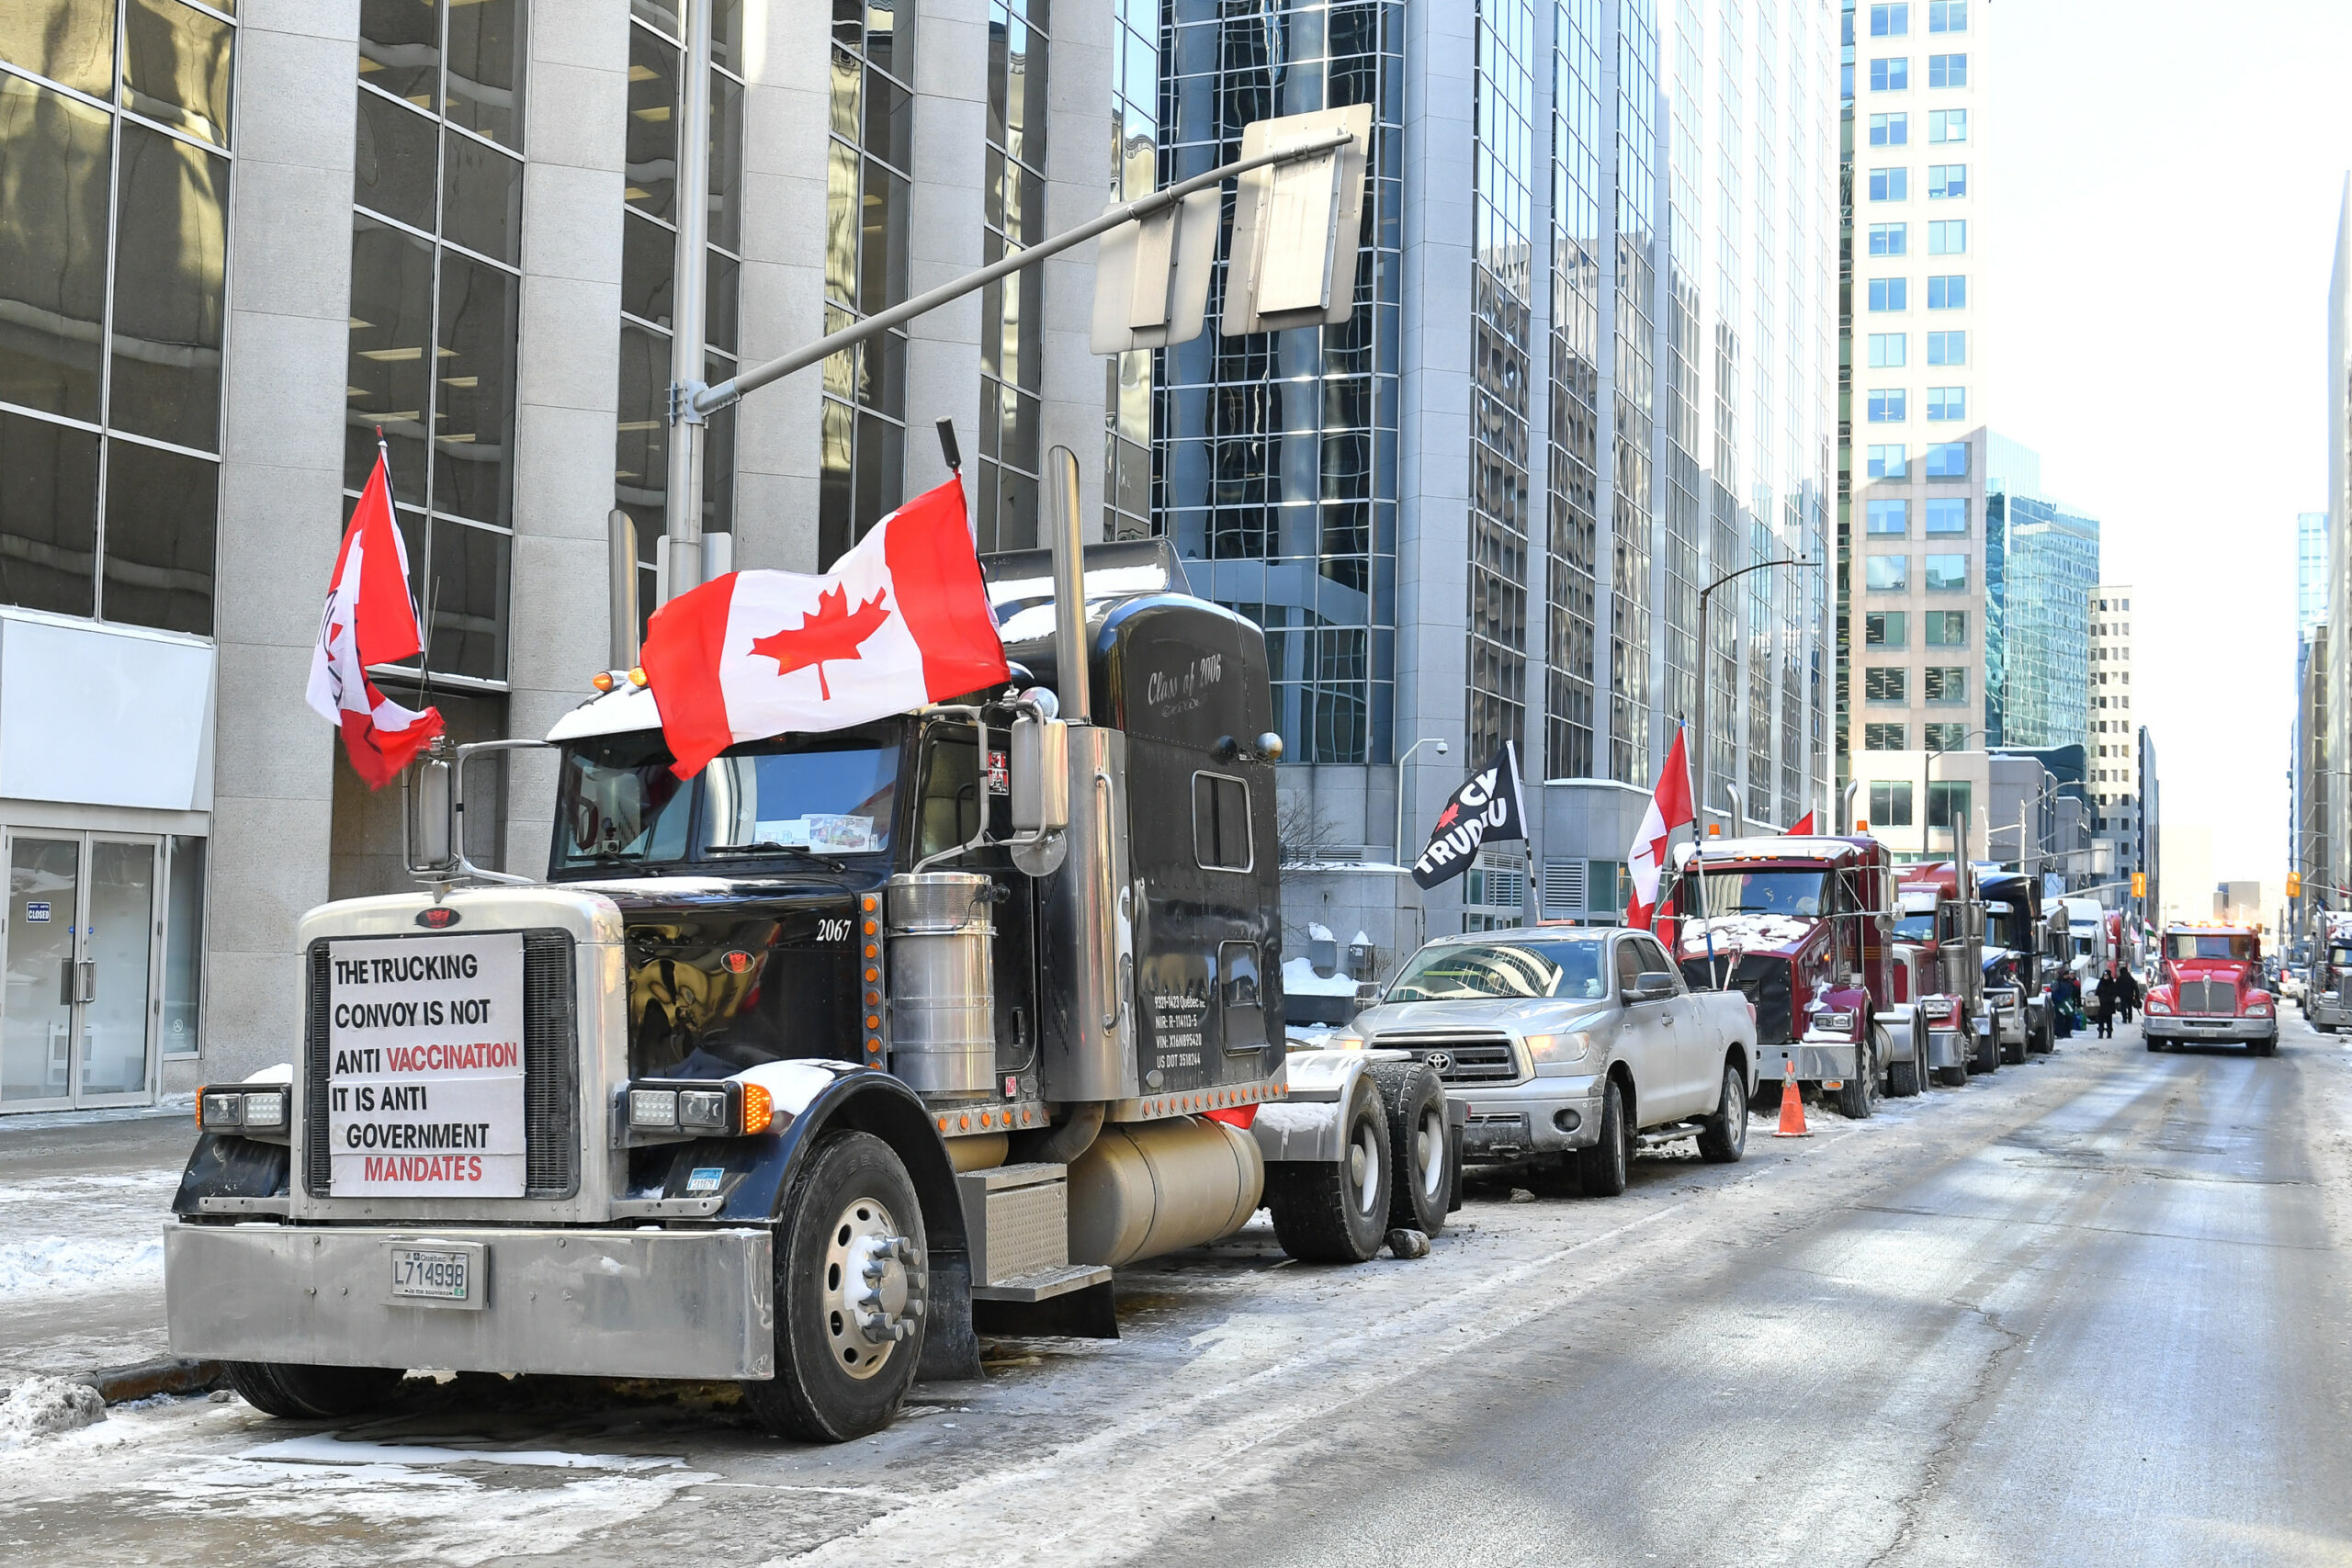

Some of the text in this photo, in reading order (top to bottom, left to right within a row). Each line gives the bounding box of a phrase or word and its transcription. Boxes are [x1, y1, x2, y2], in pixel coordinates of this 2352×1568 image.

[1148, 653, 1222, 705] Class of 2006
[28, 909, 50, 919] CLOSED
[816, 919, 853, 942] 2067
[334, 953, 478, 985] THE TRUCKING
[334, 998, 491, 1029] CONVOY IS NOT
[1154, 995, 1180, 1010] 9321-1423
[1180, 995, 1199, 1010] Québec
[1155, 1014, 1198, 1029] NIR: R-114113-5
[1155, 1034, 1169, 1049] VIN:
[334, 1042, 517, 1075] ANTI VACCINATION
[1156, 1055, 1166, 1069] US
[1166, 1054, 1178, 1068] DOT
[333, 1086, 427, 1111] IT IS ANTI
[346, 1122, 490, 1149] GOVERNMENT
[364, 1156, 482, 1182] MANDATES
[394, 1260, 464, 1287] L714998
